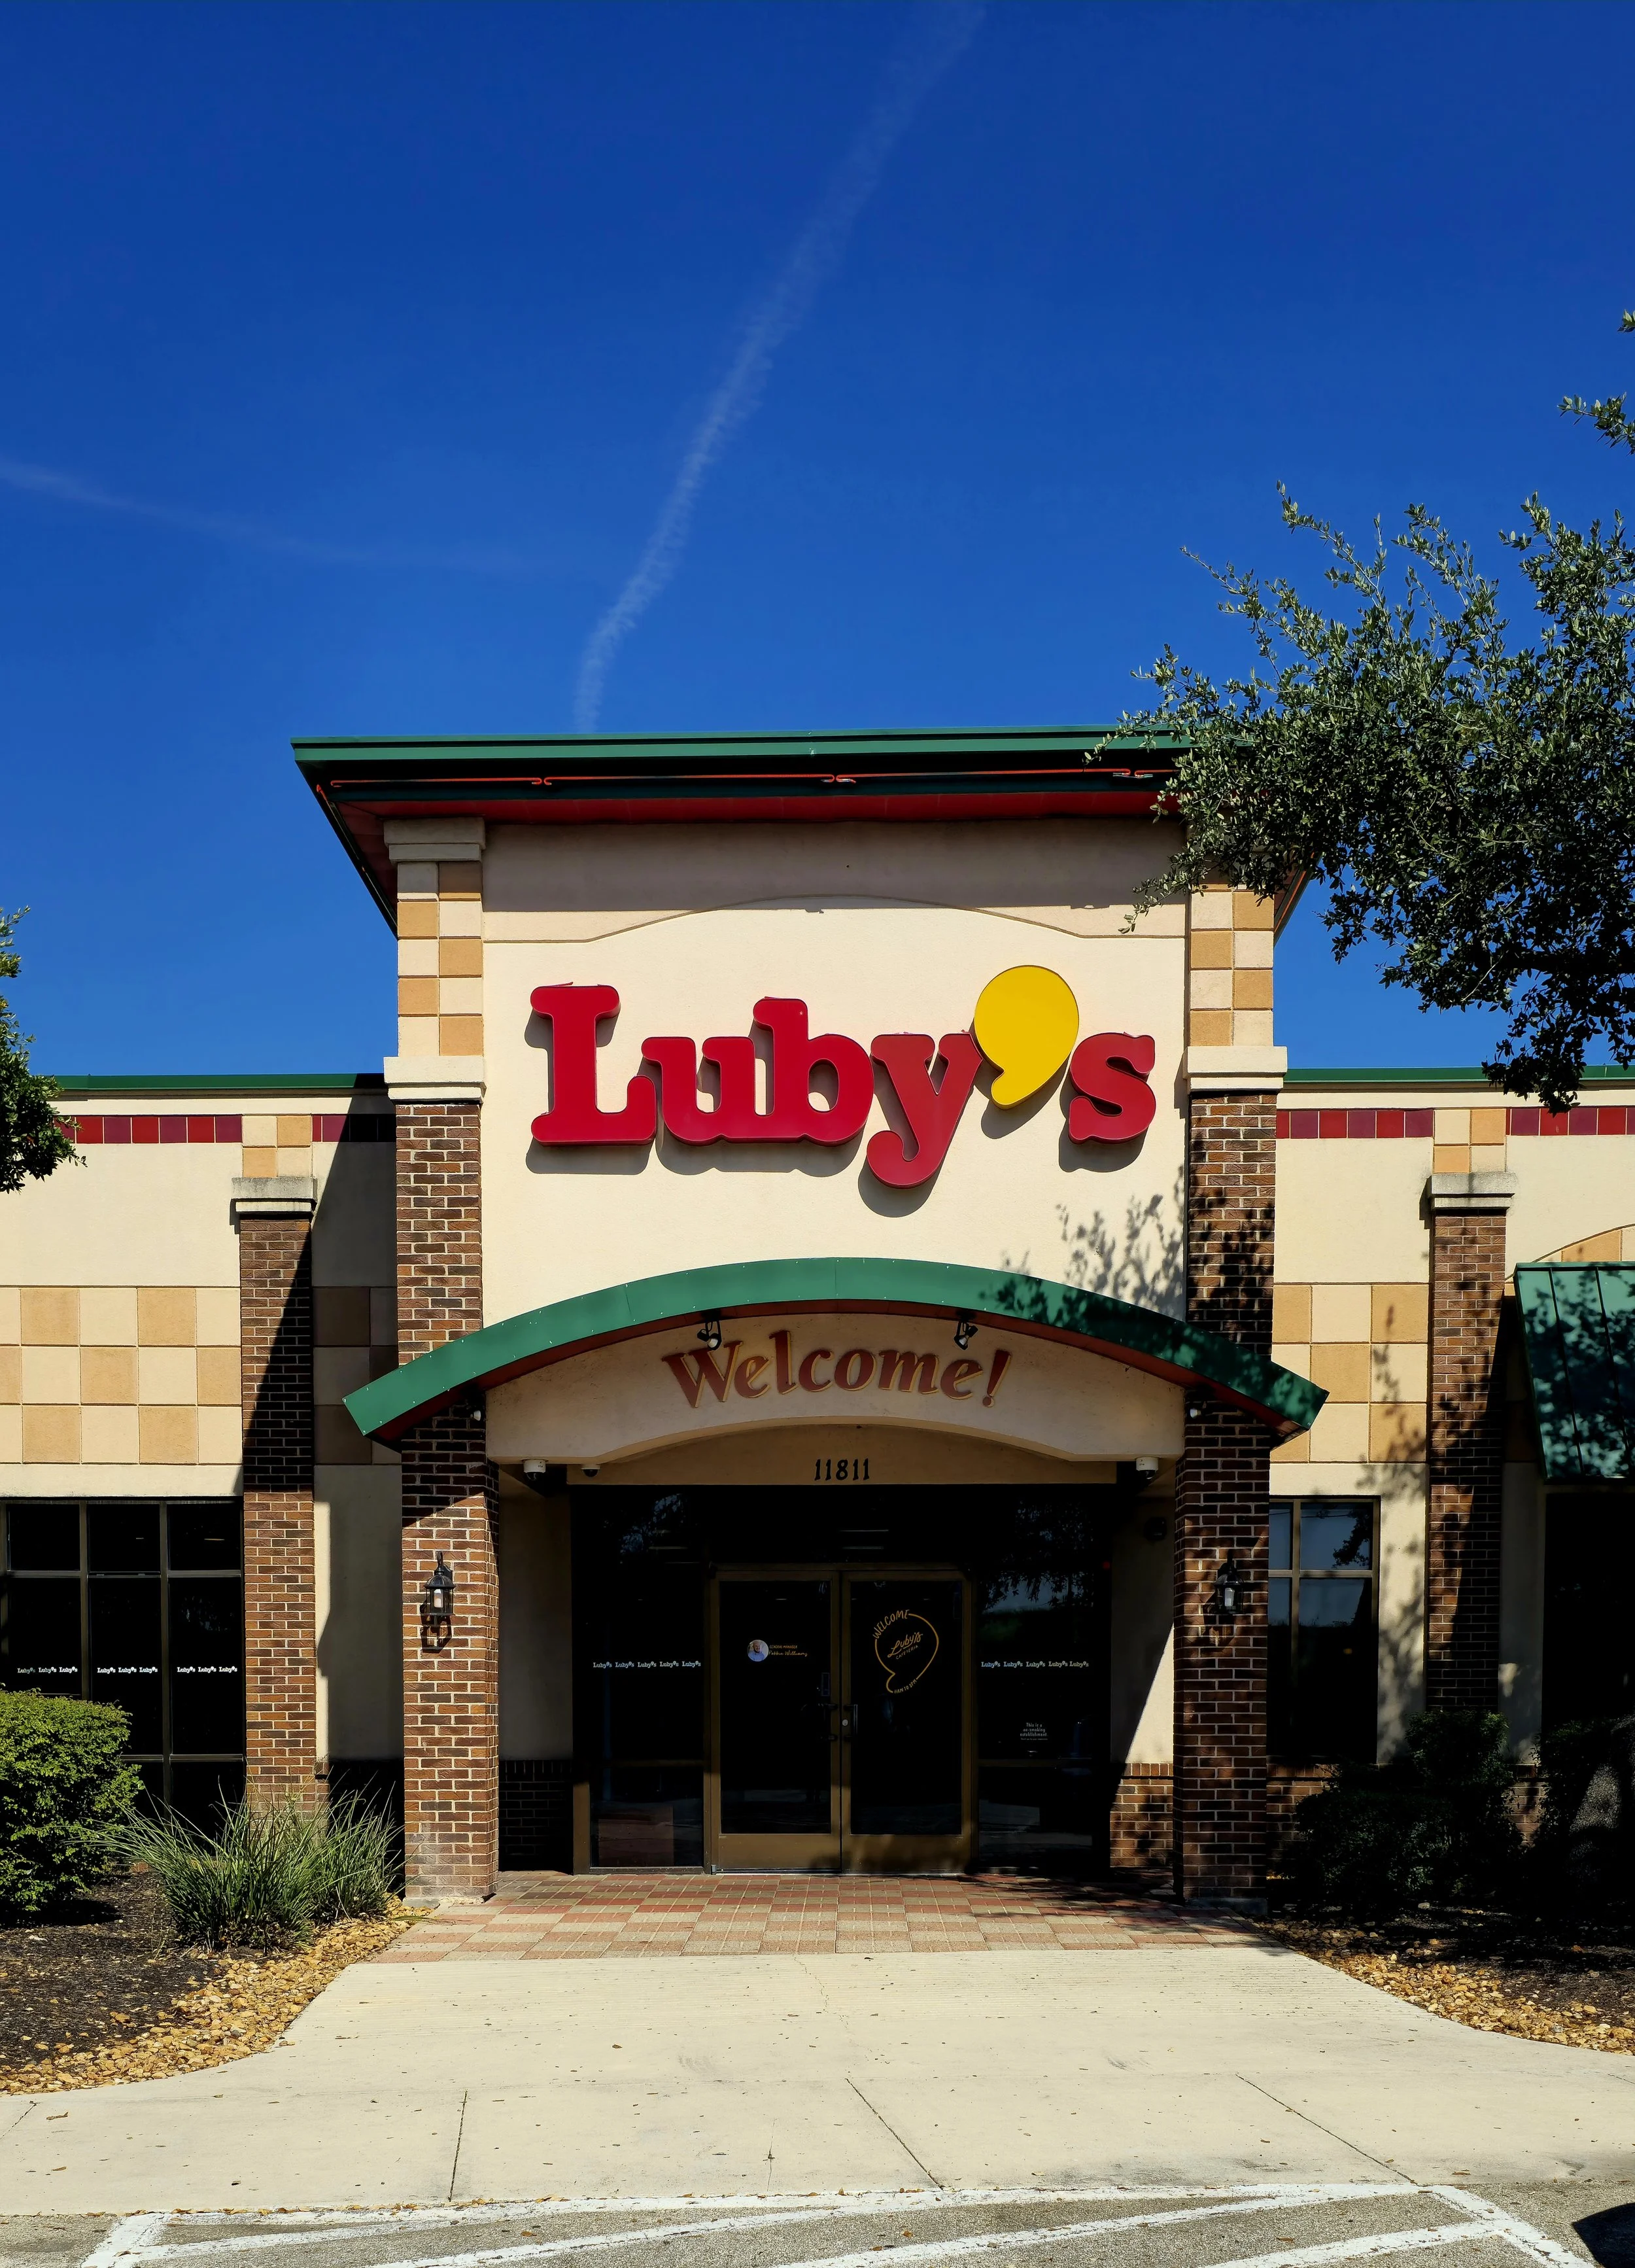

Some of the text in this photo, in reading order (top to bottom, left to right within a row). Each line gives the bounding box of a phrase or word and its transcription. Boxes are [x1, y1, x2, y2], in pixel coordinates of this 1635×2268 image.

[530, 965, 1156, 1189] Luby's
[661, 1330, 1012, 1408] Welcome!
[814, 1458, 870, 1481] 11811
[872, 1609, 910, 1639] WELCOME
[887, 1631, 923, 1658] Luby's
[896, 1645, 919, 1660] CAFETERIA
